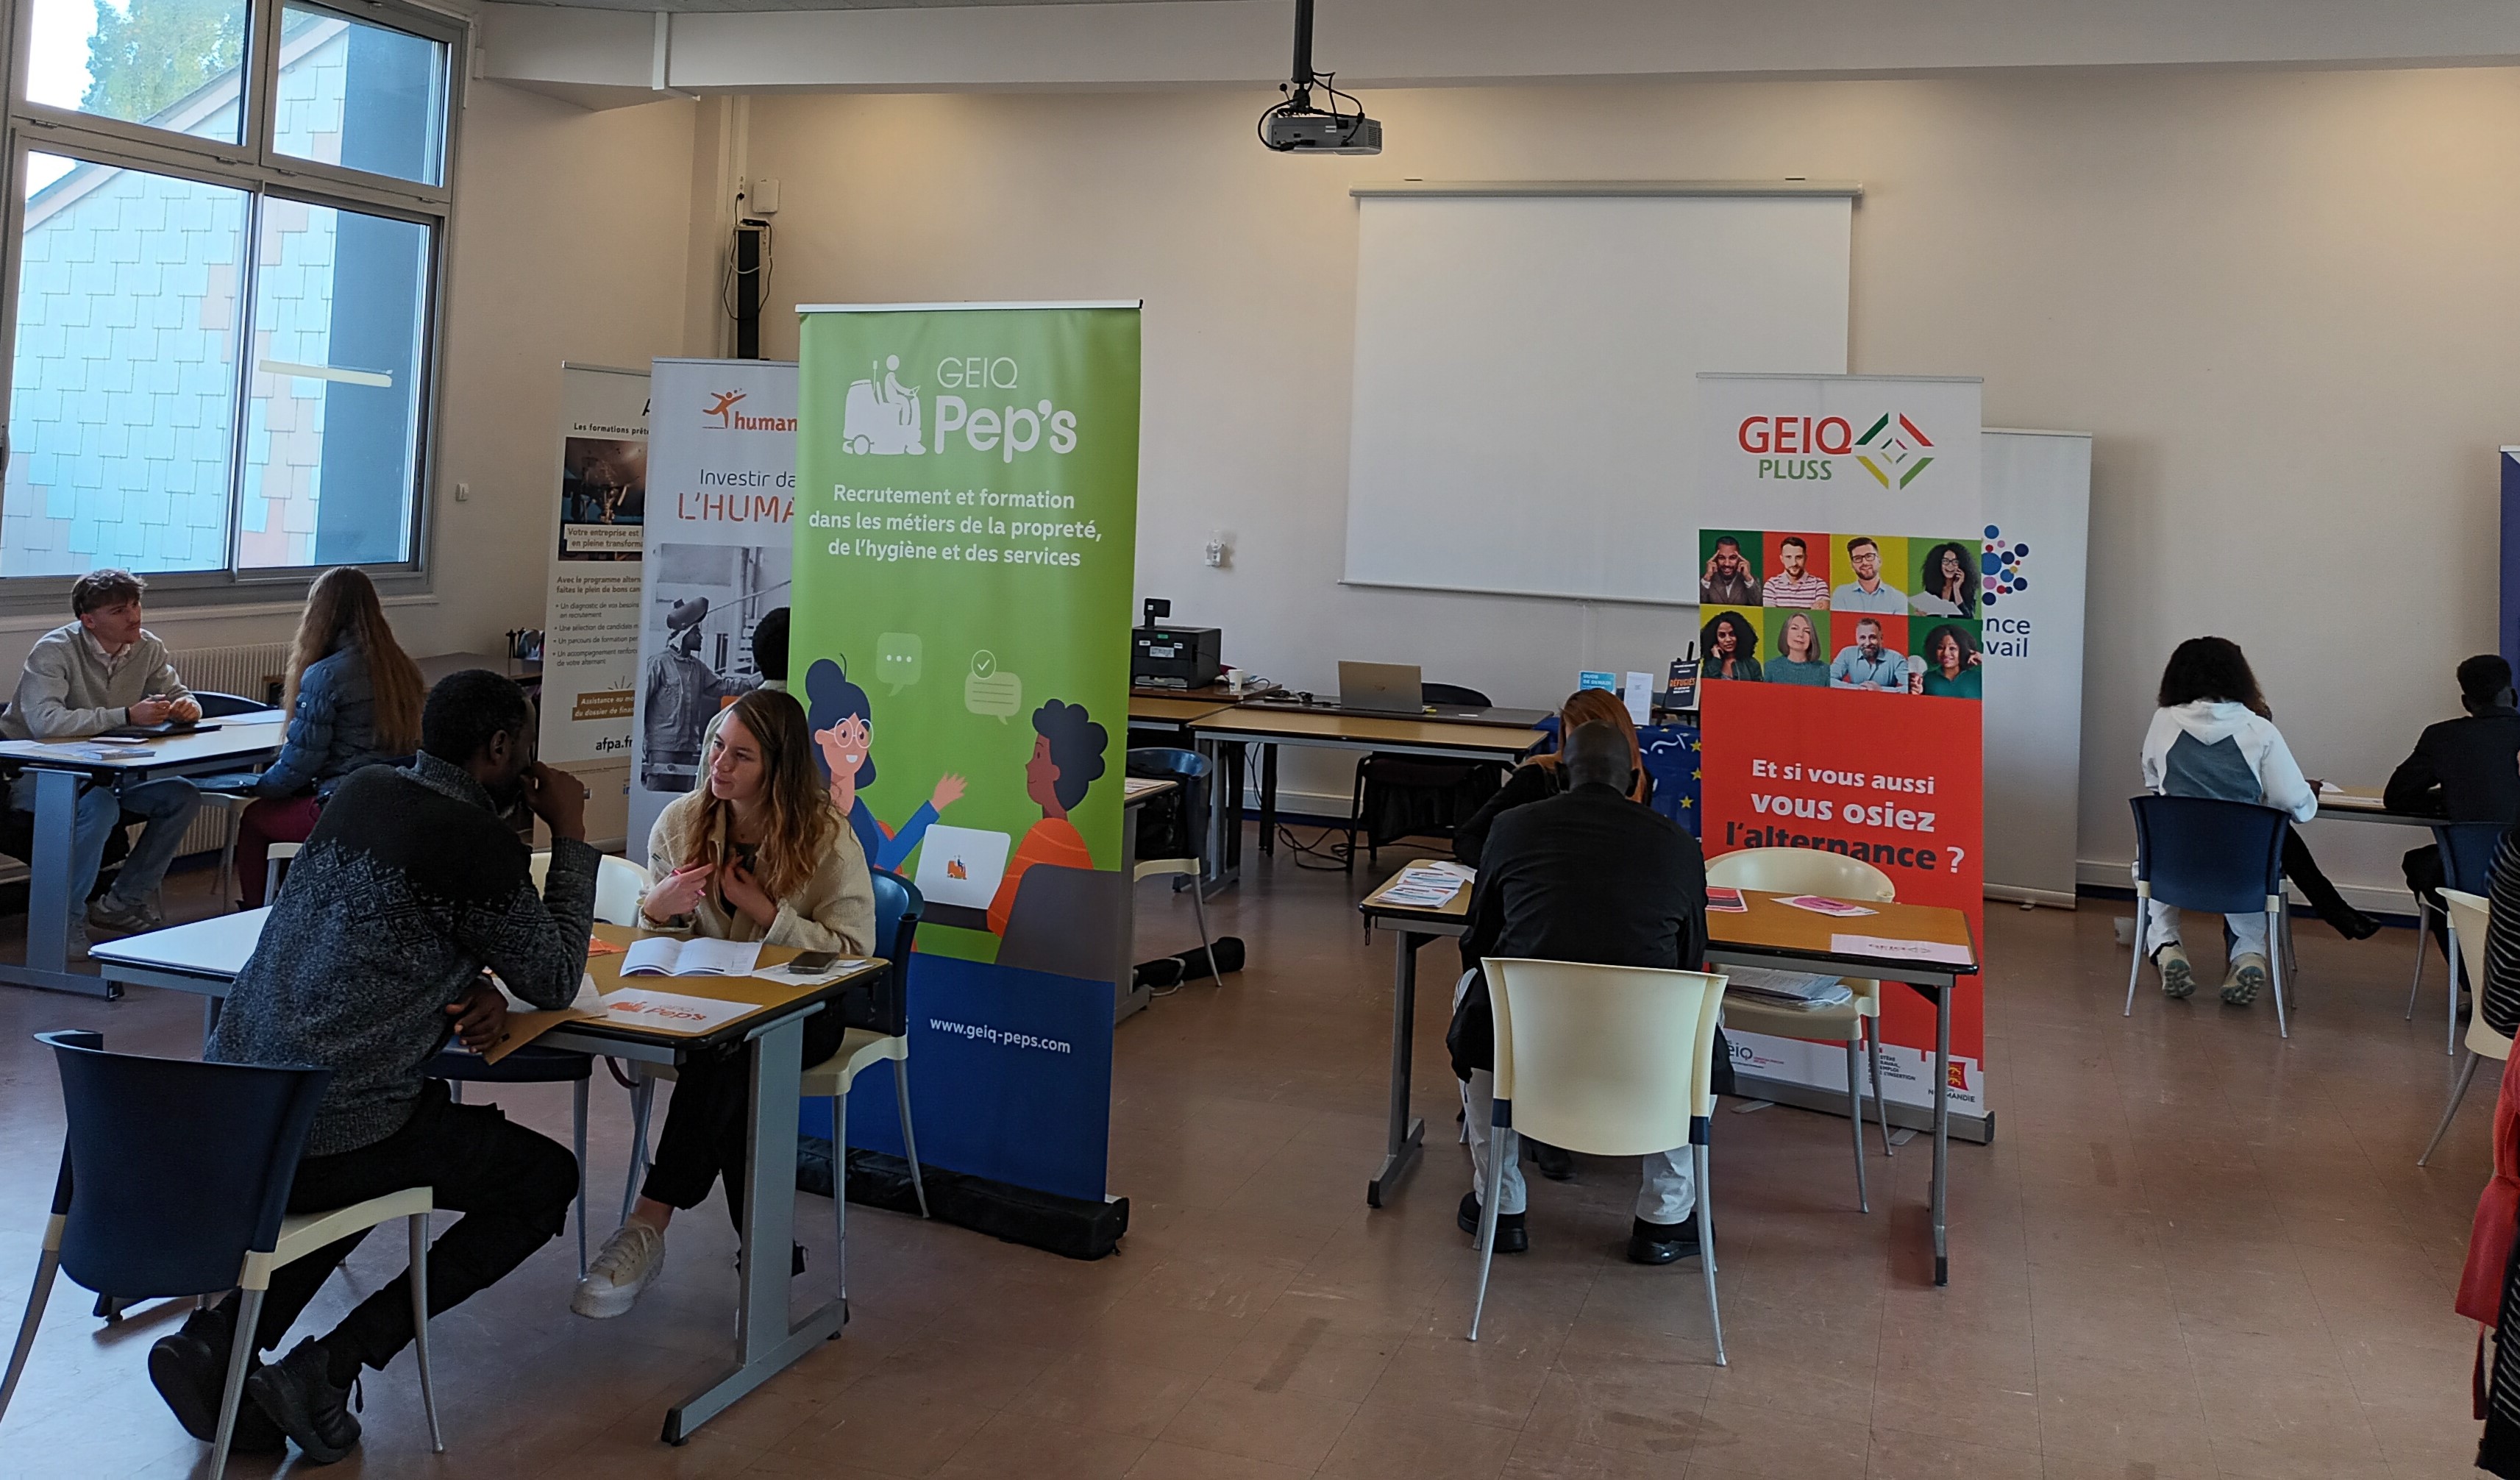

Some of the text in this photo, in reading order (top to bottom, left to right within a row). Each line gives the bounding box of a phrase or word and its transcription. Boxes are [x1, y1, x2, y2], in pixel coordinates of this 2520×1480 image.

[937, 357, 1018, 389] GEIQ
[574, 422, 587, 431] Les
[589, 423, 630, 434] formations
[735, 410, 797, 432] human
[934, 395, 1078, 463] Pep's
[1738, 416, 1853, 456] GEIQ
[700, 469, 796, 488] Investir da
[1759, 458, 1833, 481] PLUSS
[678, 492, 794, 523] L'HUMA
[833, 484, 1075, 509] Recrutement et formation
[567, 527, 639, 538] Votre entreprise est
[808, 510, 1102, 542] dans les métiers de la propreté,
[583, 538, 605, 548] pleine
[605, 539, 644, 548] transforma
[828, 538, 1081, 566] de l'hygiène et des services
[575, 575, 582, 583] le
[583, 577, 622, 585] programme
[622, 575, 641, 583] altern
[1986, 618, 2031, 635] nce
[1986, 638, 2028, 657] vail
[595, 735, 633, 753] afpa.fr
[1752, 758, 1935, 795] Et si vous aussi
[1751, 792, 1936, 833] vous osiez
[1946, 846, 1965, 874] ?
[930, 1015, 1072, 1055] www.geiq-peps.com
